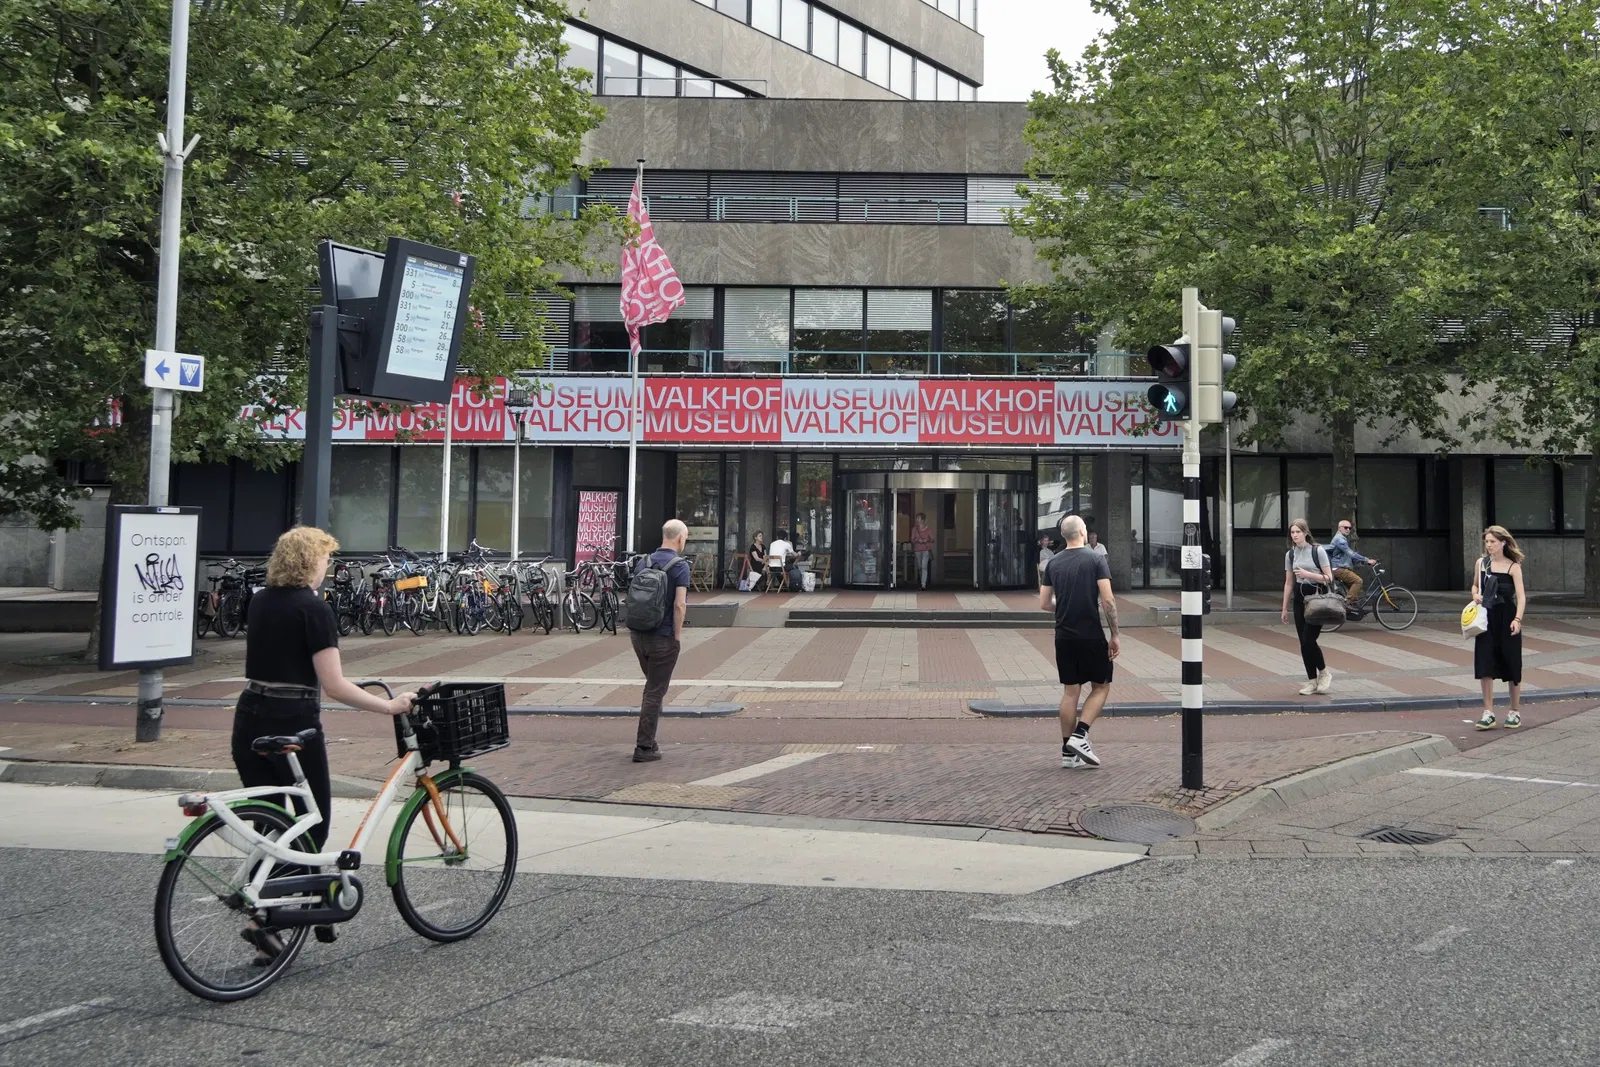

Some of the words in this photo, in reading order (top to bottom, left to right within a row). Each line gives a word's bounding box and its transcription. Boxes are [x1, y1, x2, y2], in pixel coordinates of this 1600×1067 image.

[405, 267, 418, 277] 331
[411, 280, 416, 289] 5
[401, 290, 414, 299] 300
[445, 300, 453, 309] 13
[400, 300, 412, 310] 331
[443, 311, 451, 319] 16
[405, 313, 410, 321] 5
[440, 321, 449, 330] 21
[395, 322, 408, 332] 300
[438, 332, 447, 340] 26
[397, 334, 406, 343] 58
[436, 342, 445, 351] 29
[395, 345, 404, 354] 58
[434, 353, 443, 361] 56
[530, 385, 641, 409] USEUM
[646, 386, 780, 410] VALKHOF
[783, 387, 915, 411] MUSEUM
[920, 388, 1053, 412] VALKHOF
[1056, 389, 1150, 413] MUSE
[507, 409, 642, 433] VALKHOF
[645, 410, 778, 434] MUSEUM
[783, 411, 917, 434] VALKHOF
[920, 412, 1051, 436] MUSEUM
[580, 491, 619, 503] VALKHOF
[579, 502, 617, 513] MUSEUM
[578, 512, 617, 523] VALKHOF
[577, 522, 616, 533] MUSEUM
[131, 533, 187, 549] Ontspan.
[132, 591, 144, 603] is
[148, 589, 183, 603] onder
[131, 607, 184, 623] controle.
